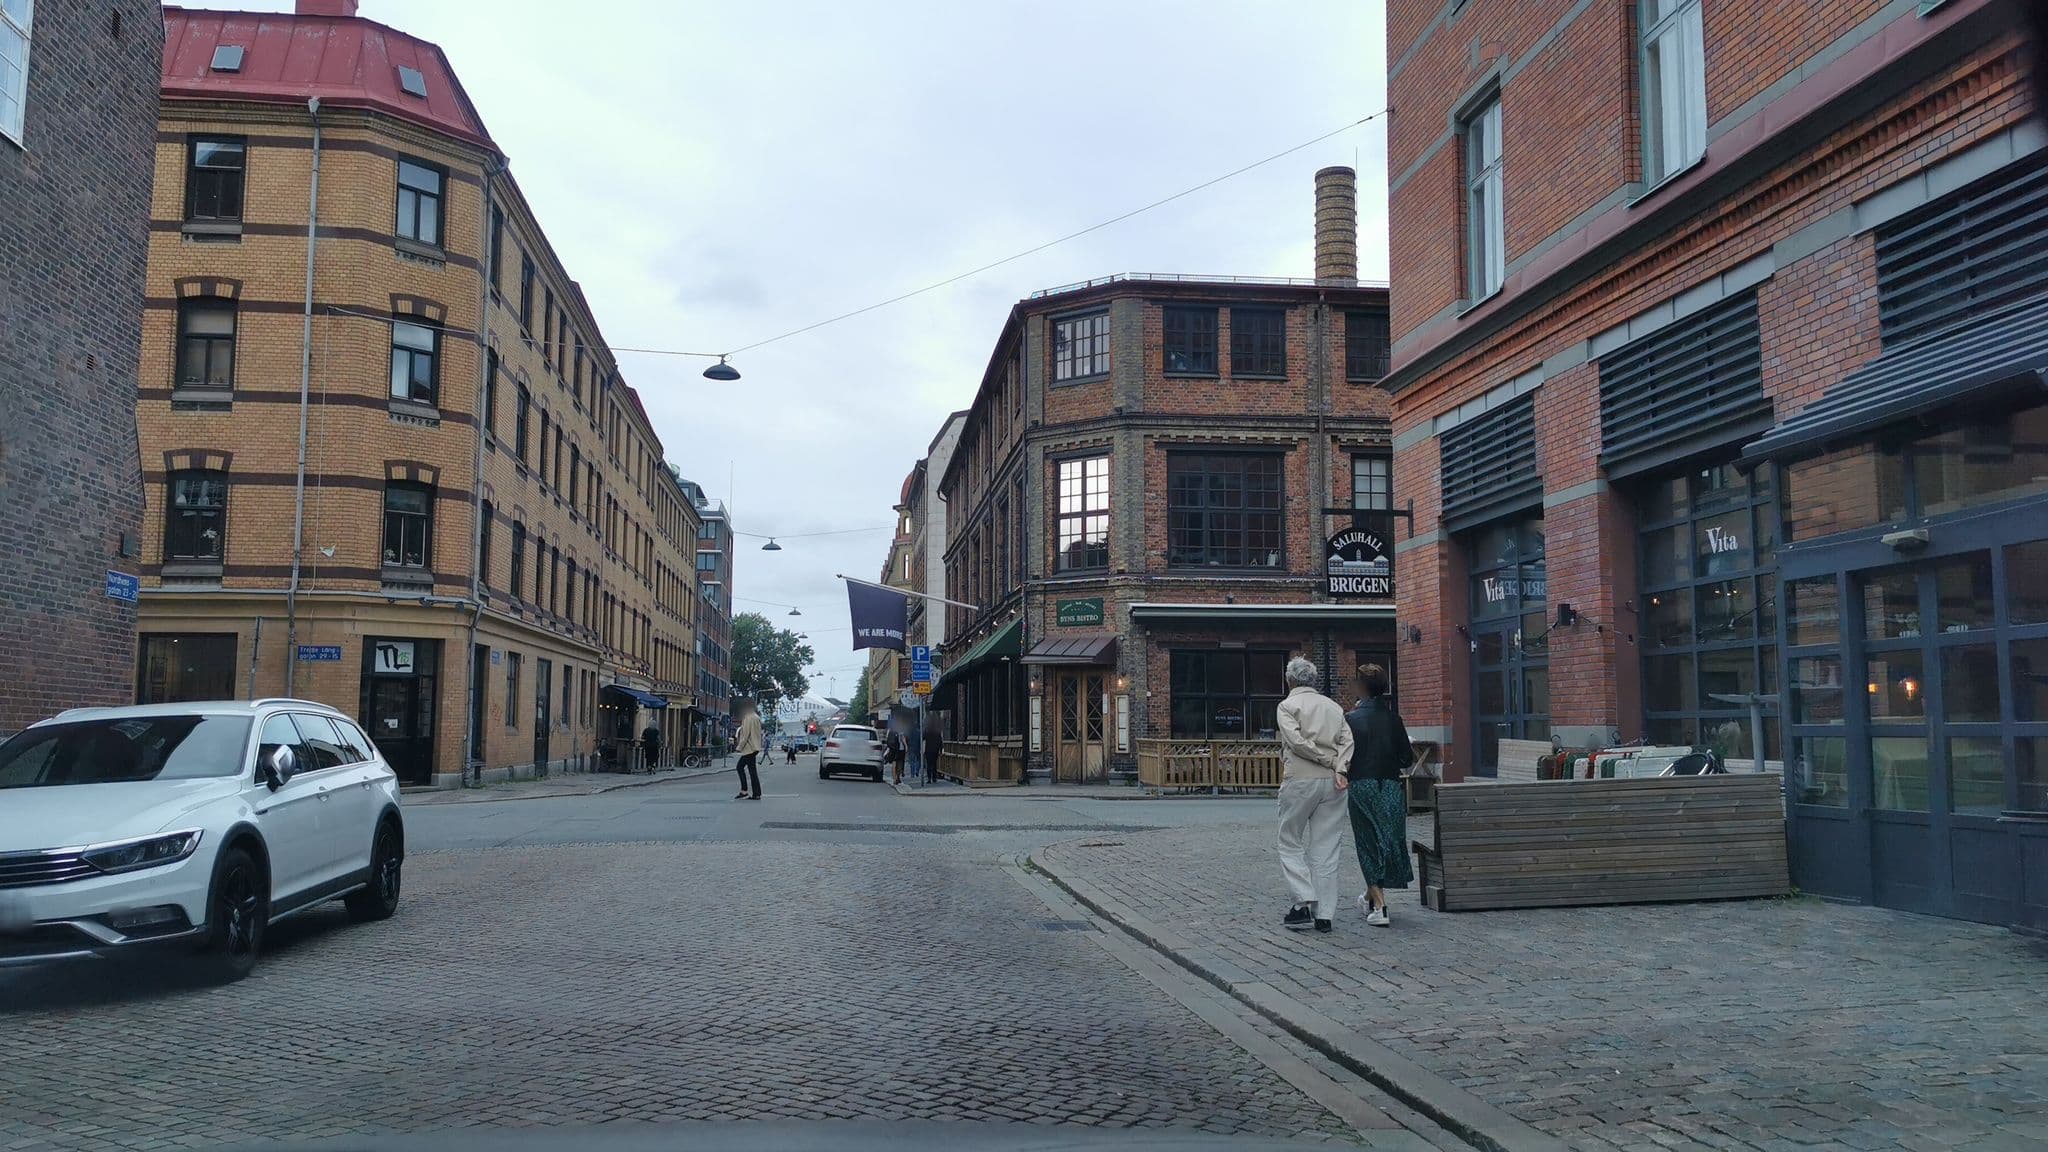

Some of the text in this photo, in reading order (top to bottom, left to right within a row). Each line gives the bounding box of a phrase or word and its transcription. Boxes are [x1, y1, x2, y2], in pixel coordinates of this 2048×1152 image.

[1332, 532, 1383, 552] SALUHALL
[1705, 526, 1739, 554] Vita
[1329, 577, 1389, 593] BRIGGEN
[1482, 577, 1505, 603] Vita
[857, 628, 903, 641] WE ARE MORE
[916, 647, 926, 661] P
